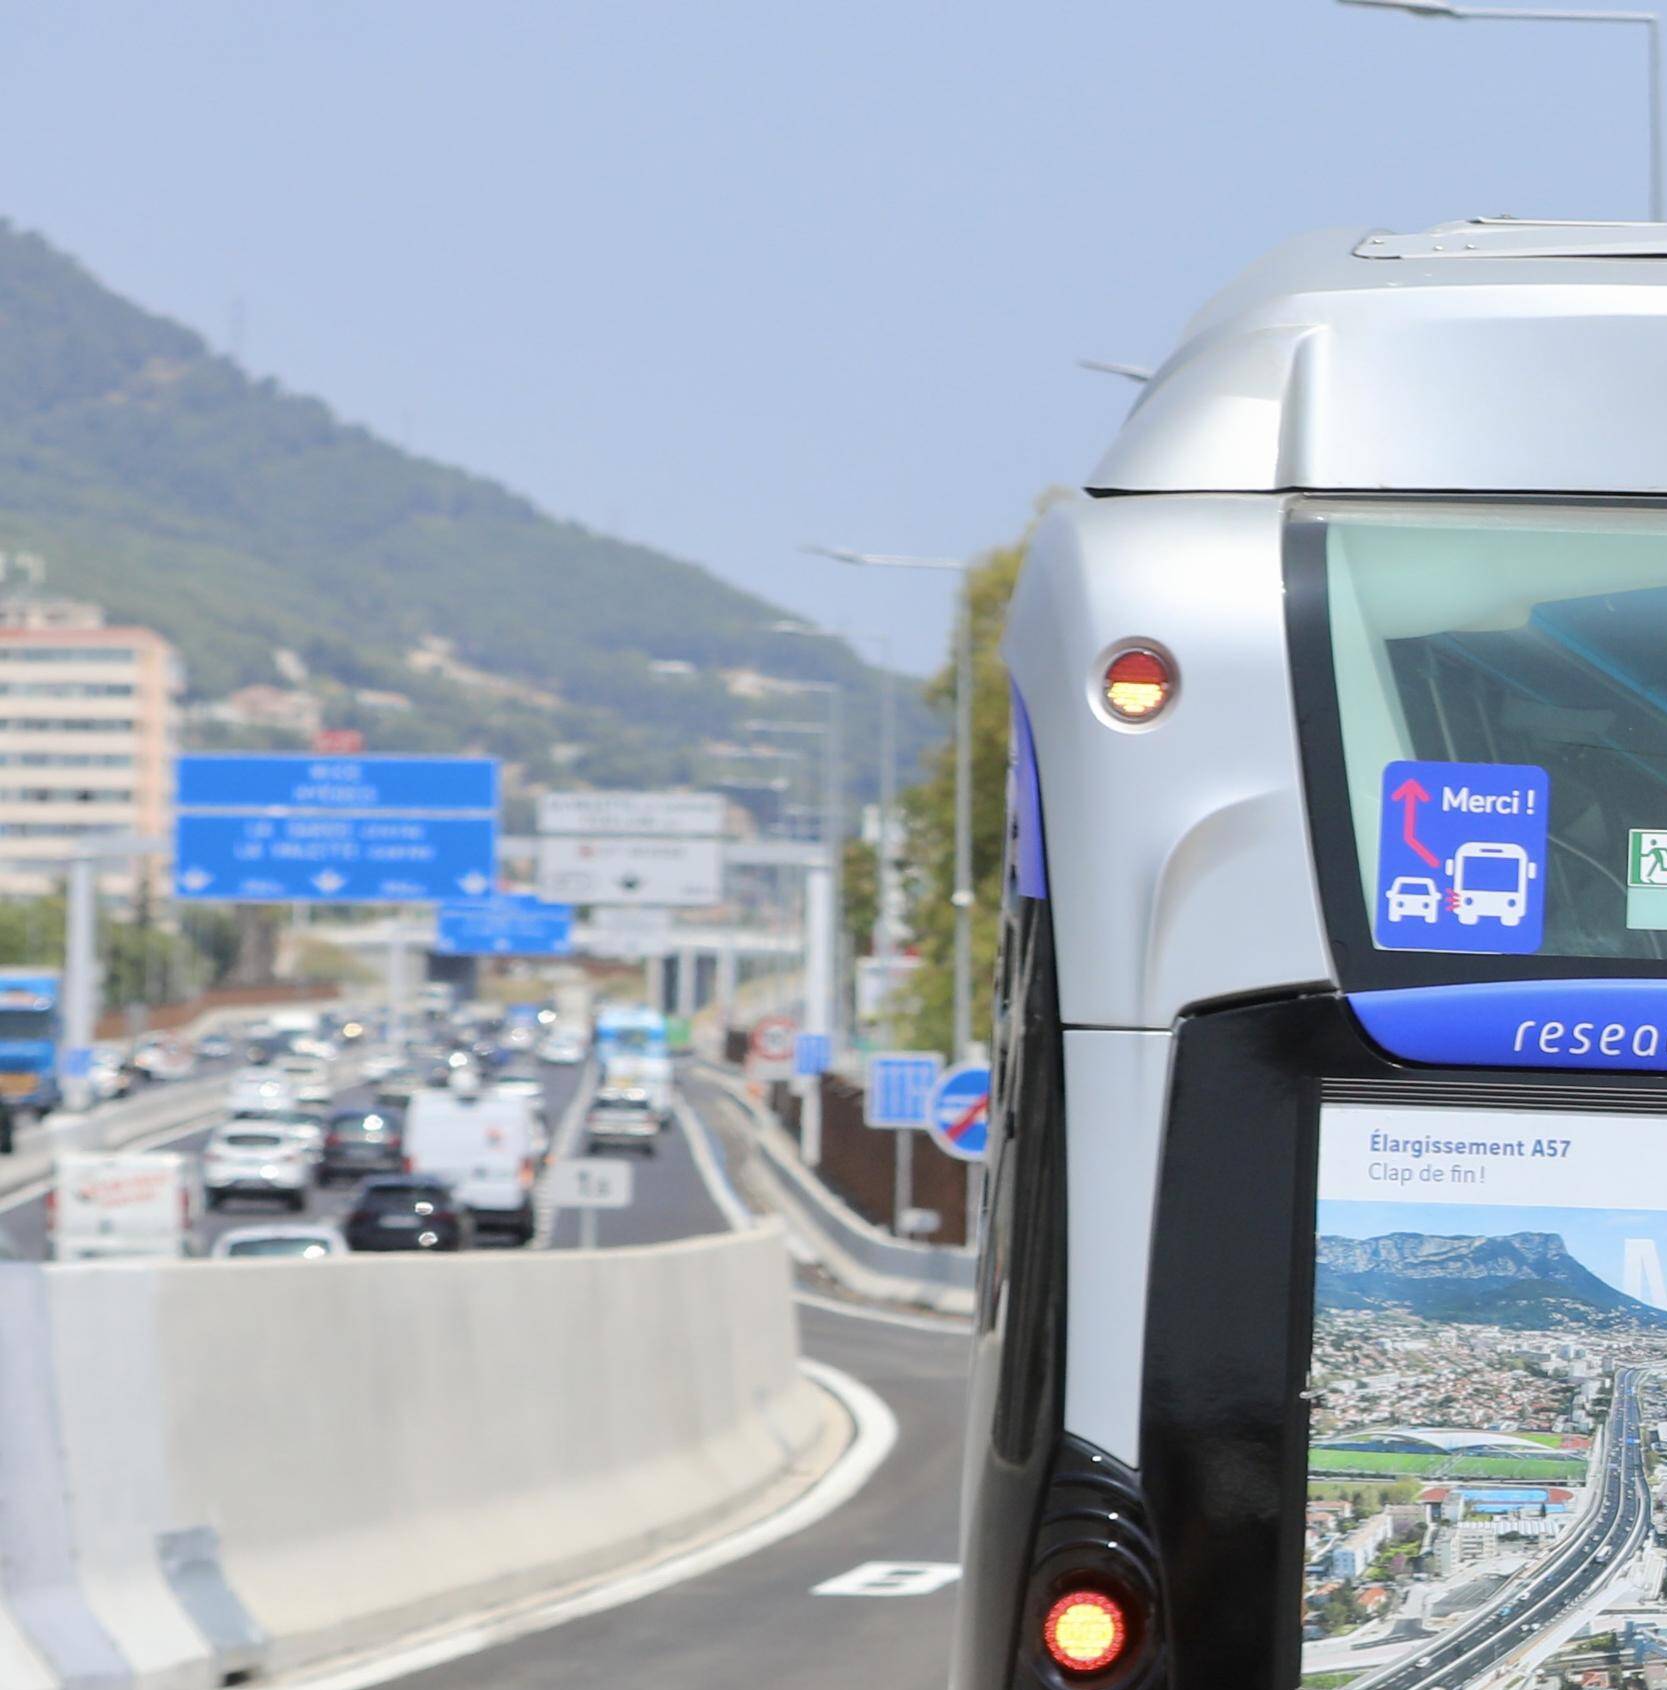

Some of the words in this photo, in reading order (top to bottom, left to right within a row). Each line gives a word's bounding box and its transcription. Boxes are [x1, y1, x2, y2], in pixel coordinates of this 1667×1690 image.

[1442, 786, 1520, 815] Merci
[1369, 1128, 1525, 1159] Élargissement
[1531, 1139, 1571, 1158] A57
[1368, 1162, 1413, 1187] Clap
[1418, 1164, 1445, 1183] de
